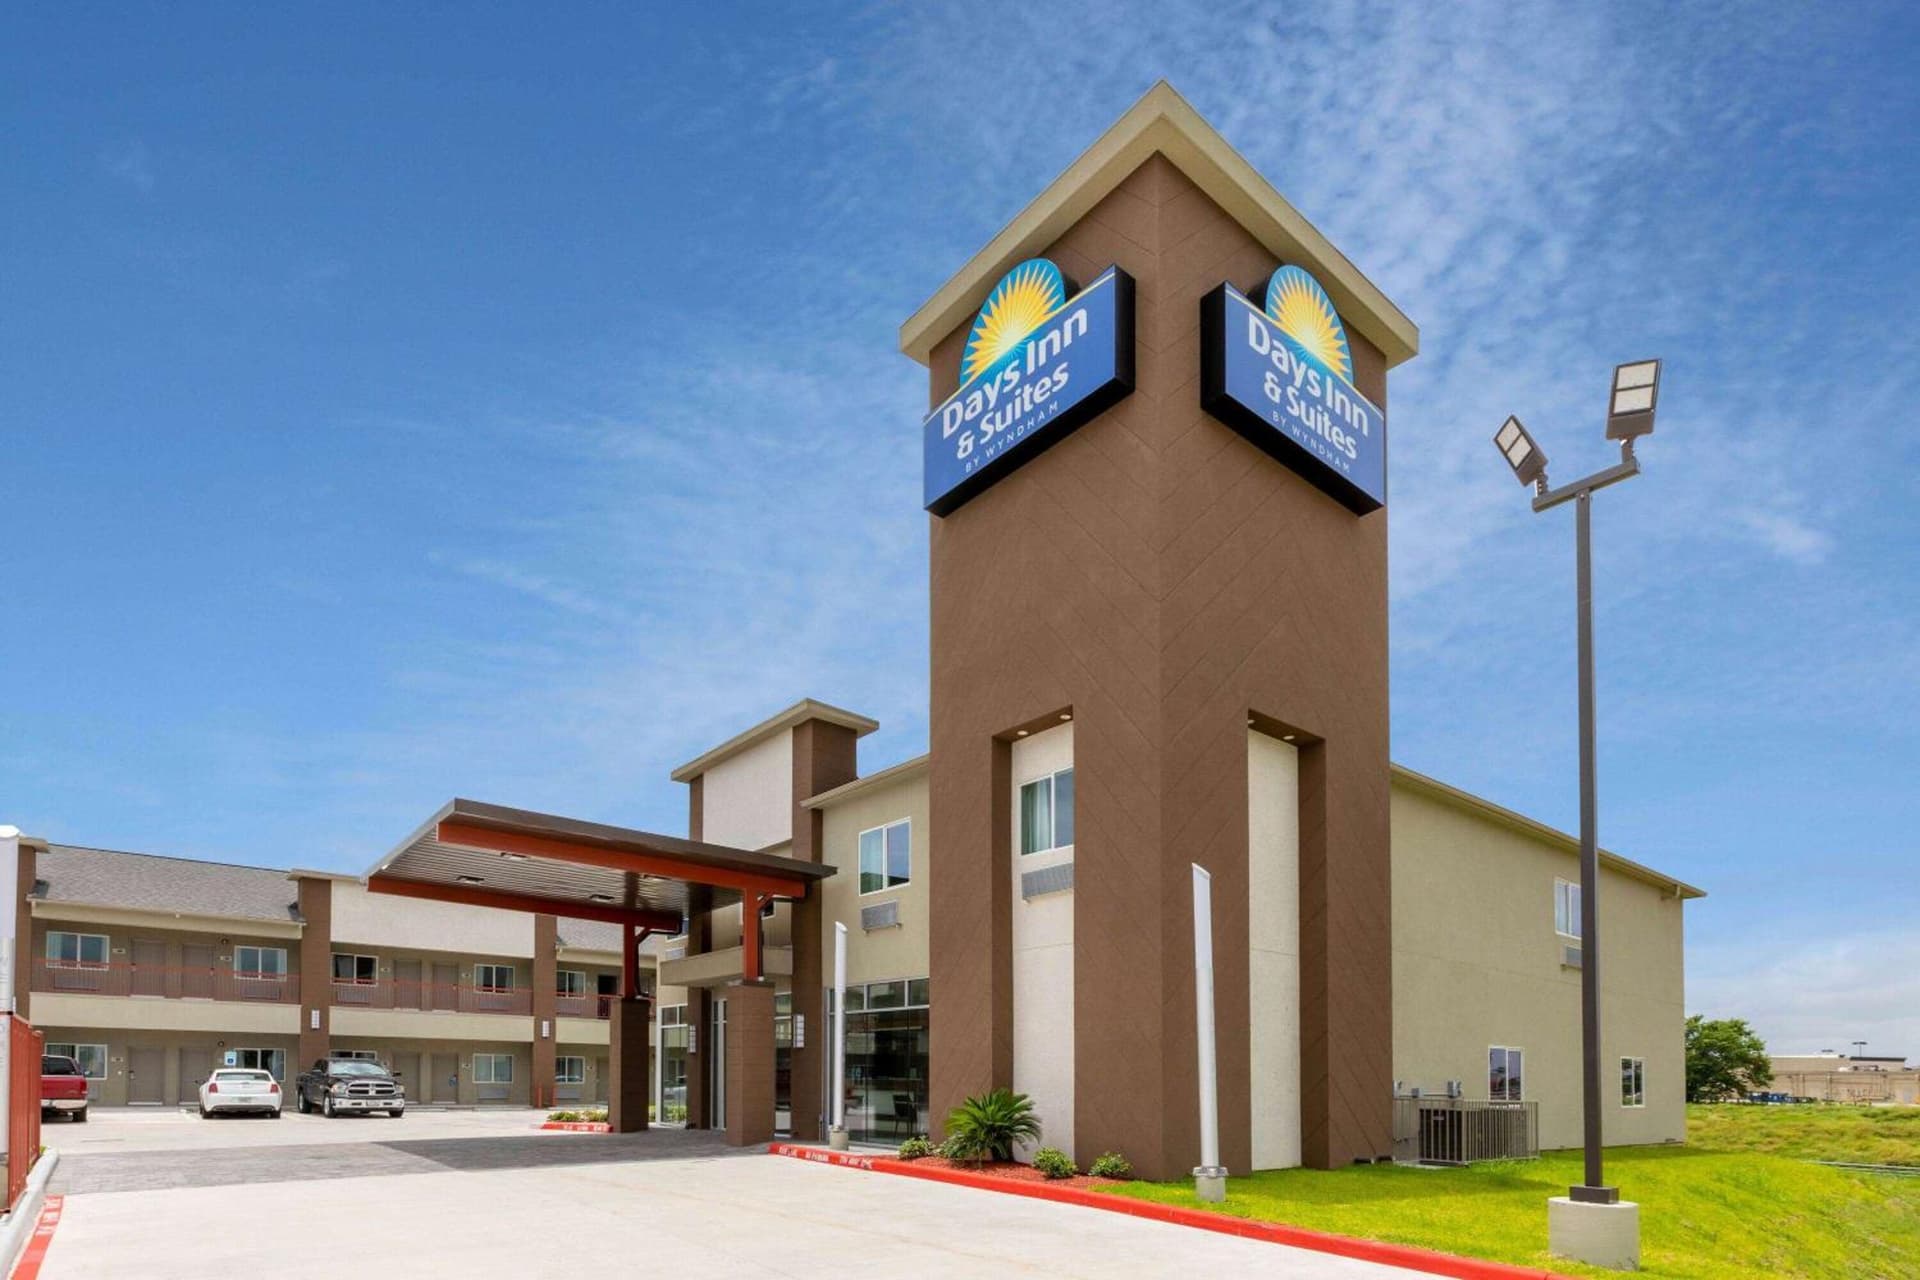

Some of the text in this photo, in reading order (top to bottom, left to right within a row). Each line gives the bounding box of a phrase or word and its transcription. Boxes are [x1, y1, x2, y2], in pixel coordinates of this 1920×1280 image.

[942, 307, 1088, 440] Days Inn
[956, 362, 1070, 460] & Suites
[1248, 311, 1369, 437] Days Inn
[1263, 370, 1357, 460] & Suites
[965, 401, 1059, 473] BY WYNDHAM
[1272, 410, 1350, 474] BY WYNDHAM
